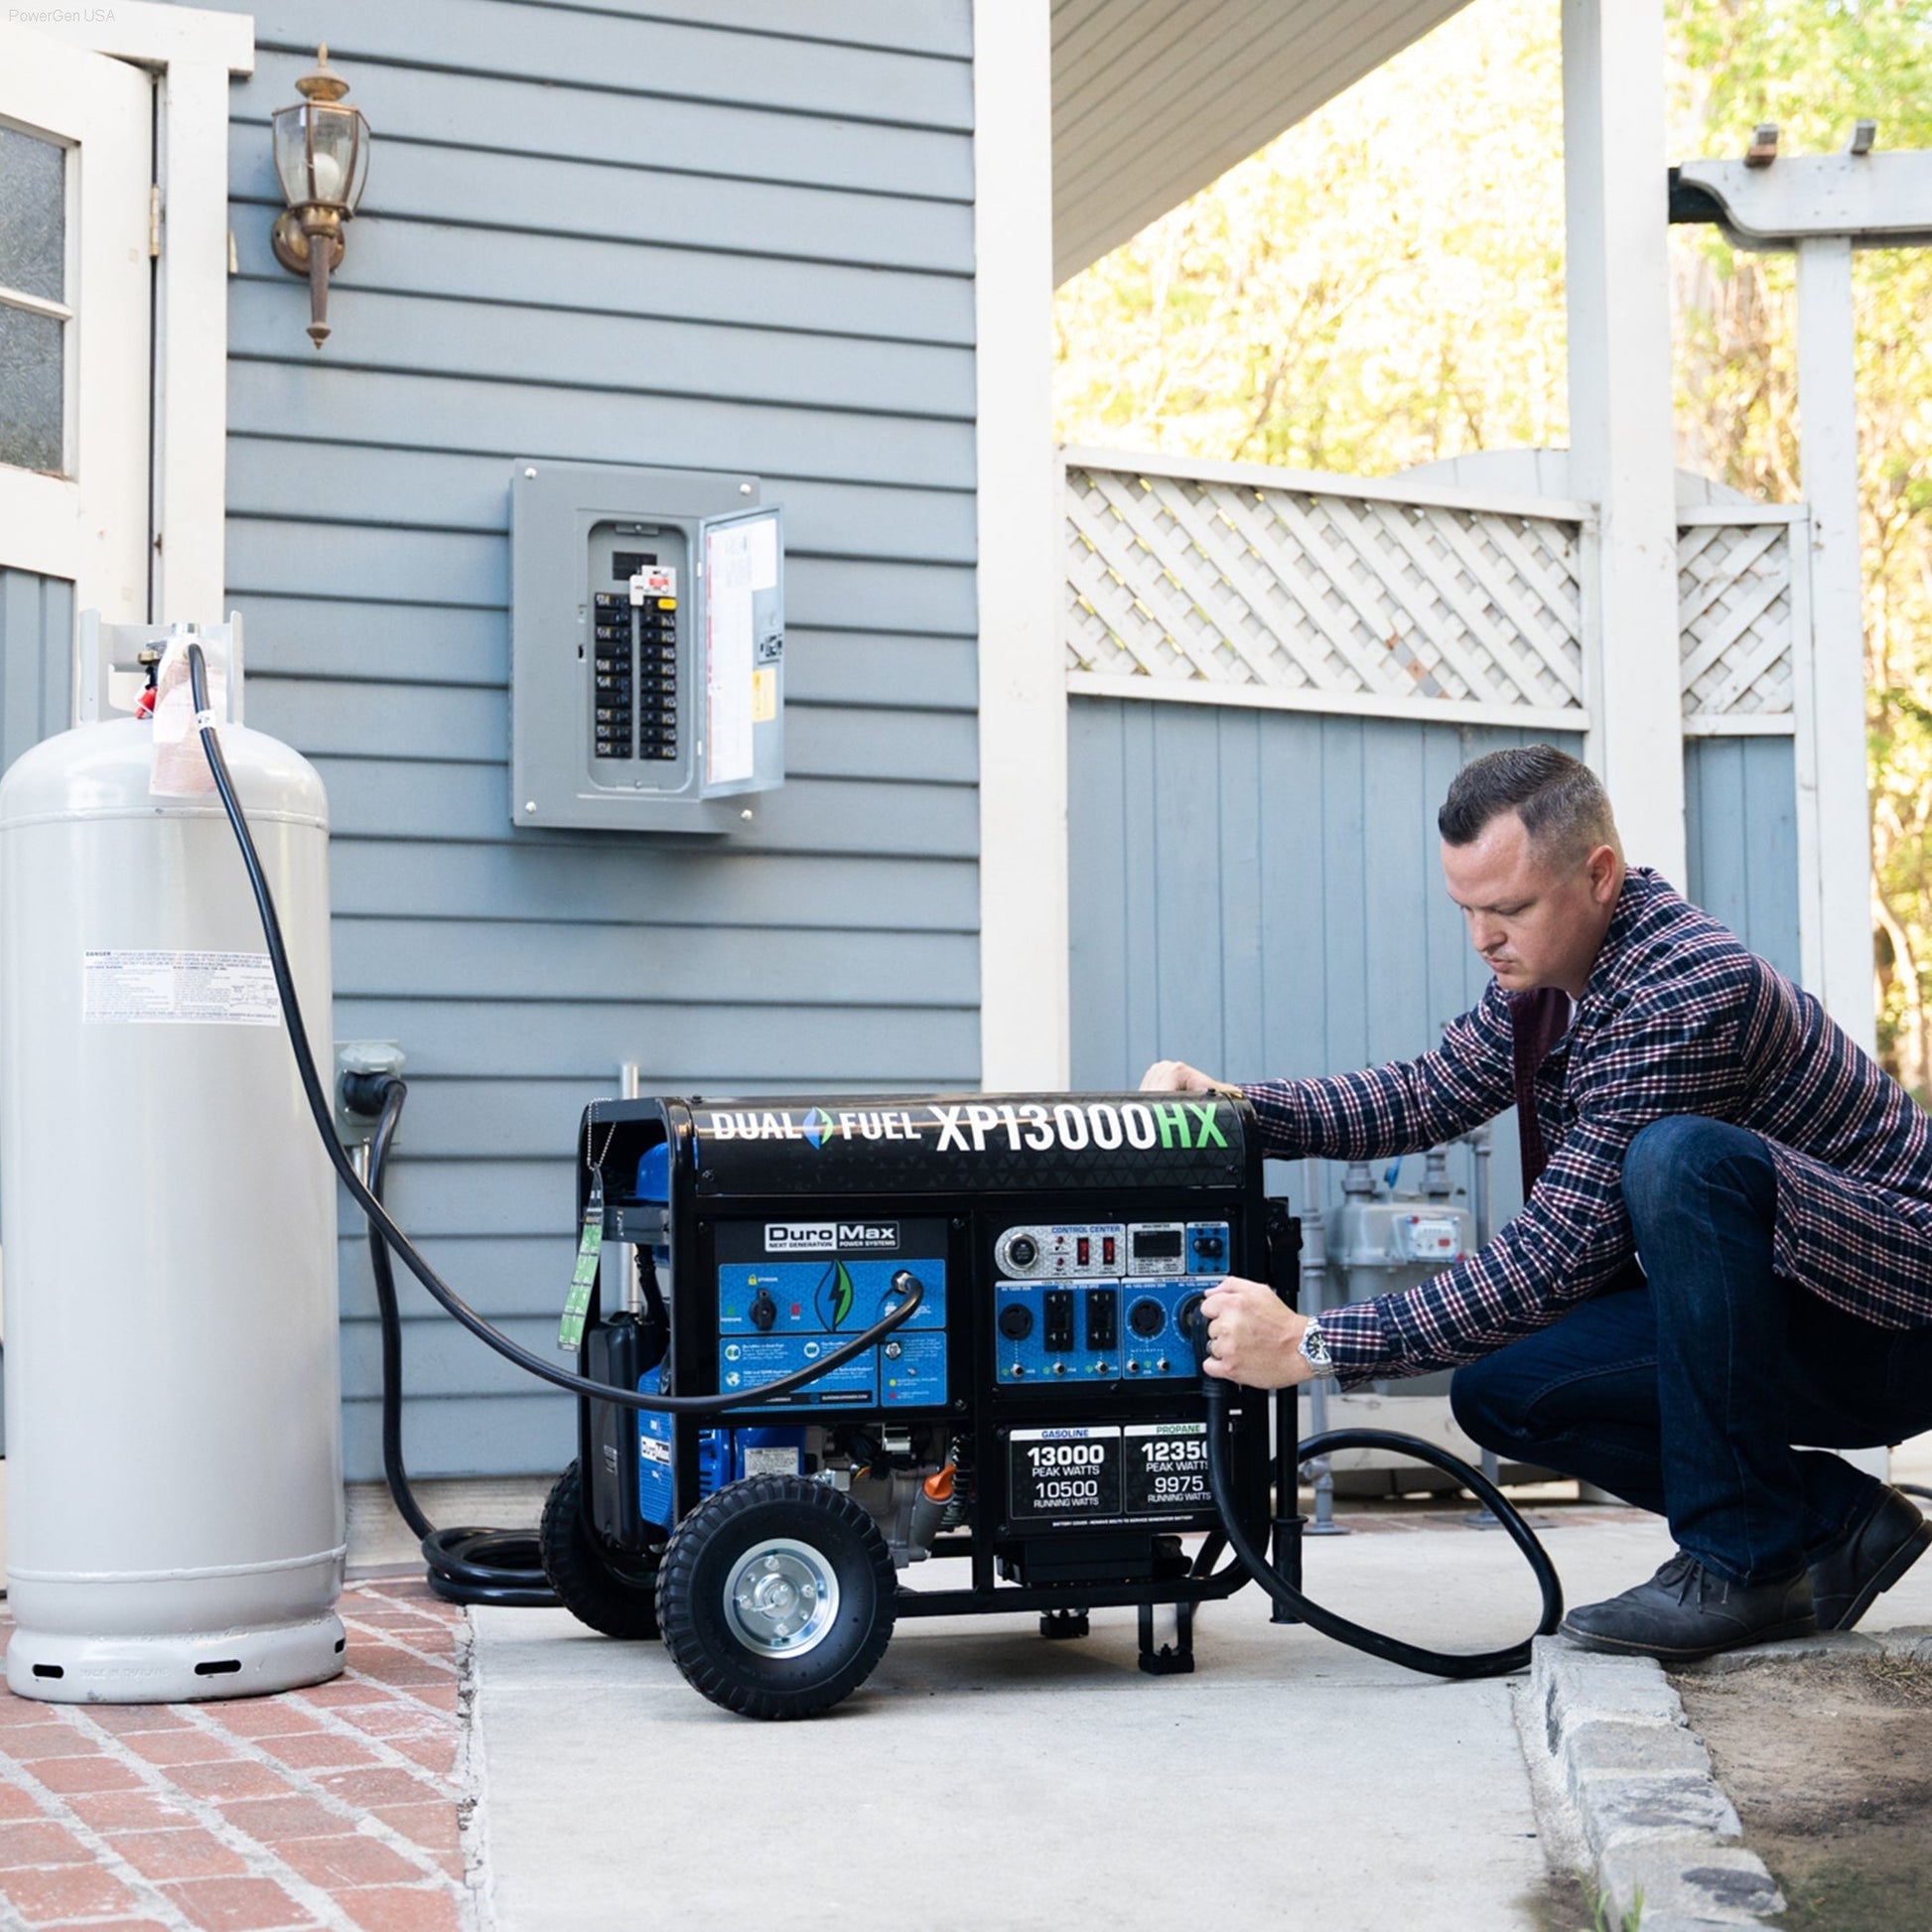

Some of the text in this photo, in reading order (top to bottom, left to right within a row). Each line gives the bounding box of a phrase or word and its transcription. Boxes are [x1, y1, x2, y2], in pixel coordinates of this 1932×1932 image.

[710, 1103, 1228, 1152] DUAL FUEL XP13000HX
[1041, 1430, 1089, 1439] GASOLINE
[1157, 1425, 1201, 1434] PROPANE
[1027, 1445, 1105, 1466] 13000
[1033, 1464, 1100, 1477] PEAK WATTS
[1146, 1462, 1173, 1472] PEAK
[1035, 1480, 1098, 1498] 10500
[1155, 1475, 1204, 1493] 9975
[1034, 1496, 1099, 1508] RUNNING WATTS
[1147, 1491, 1211, 1503] RUNNING WATTS
